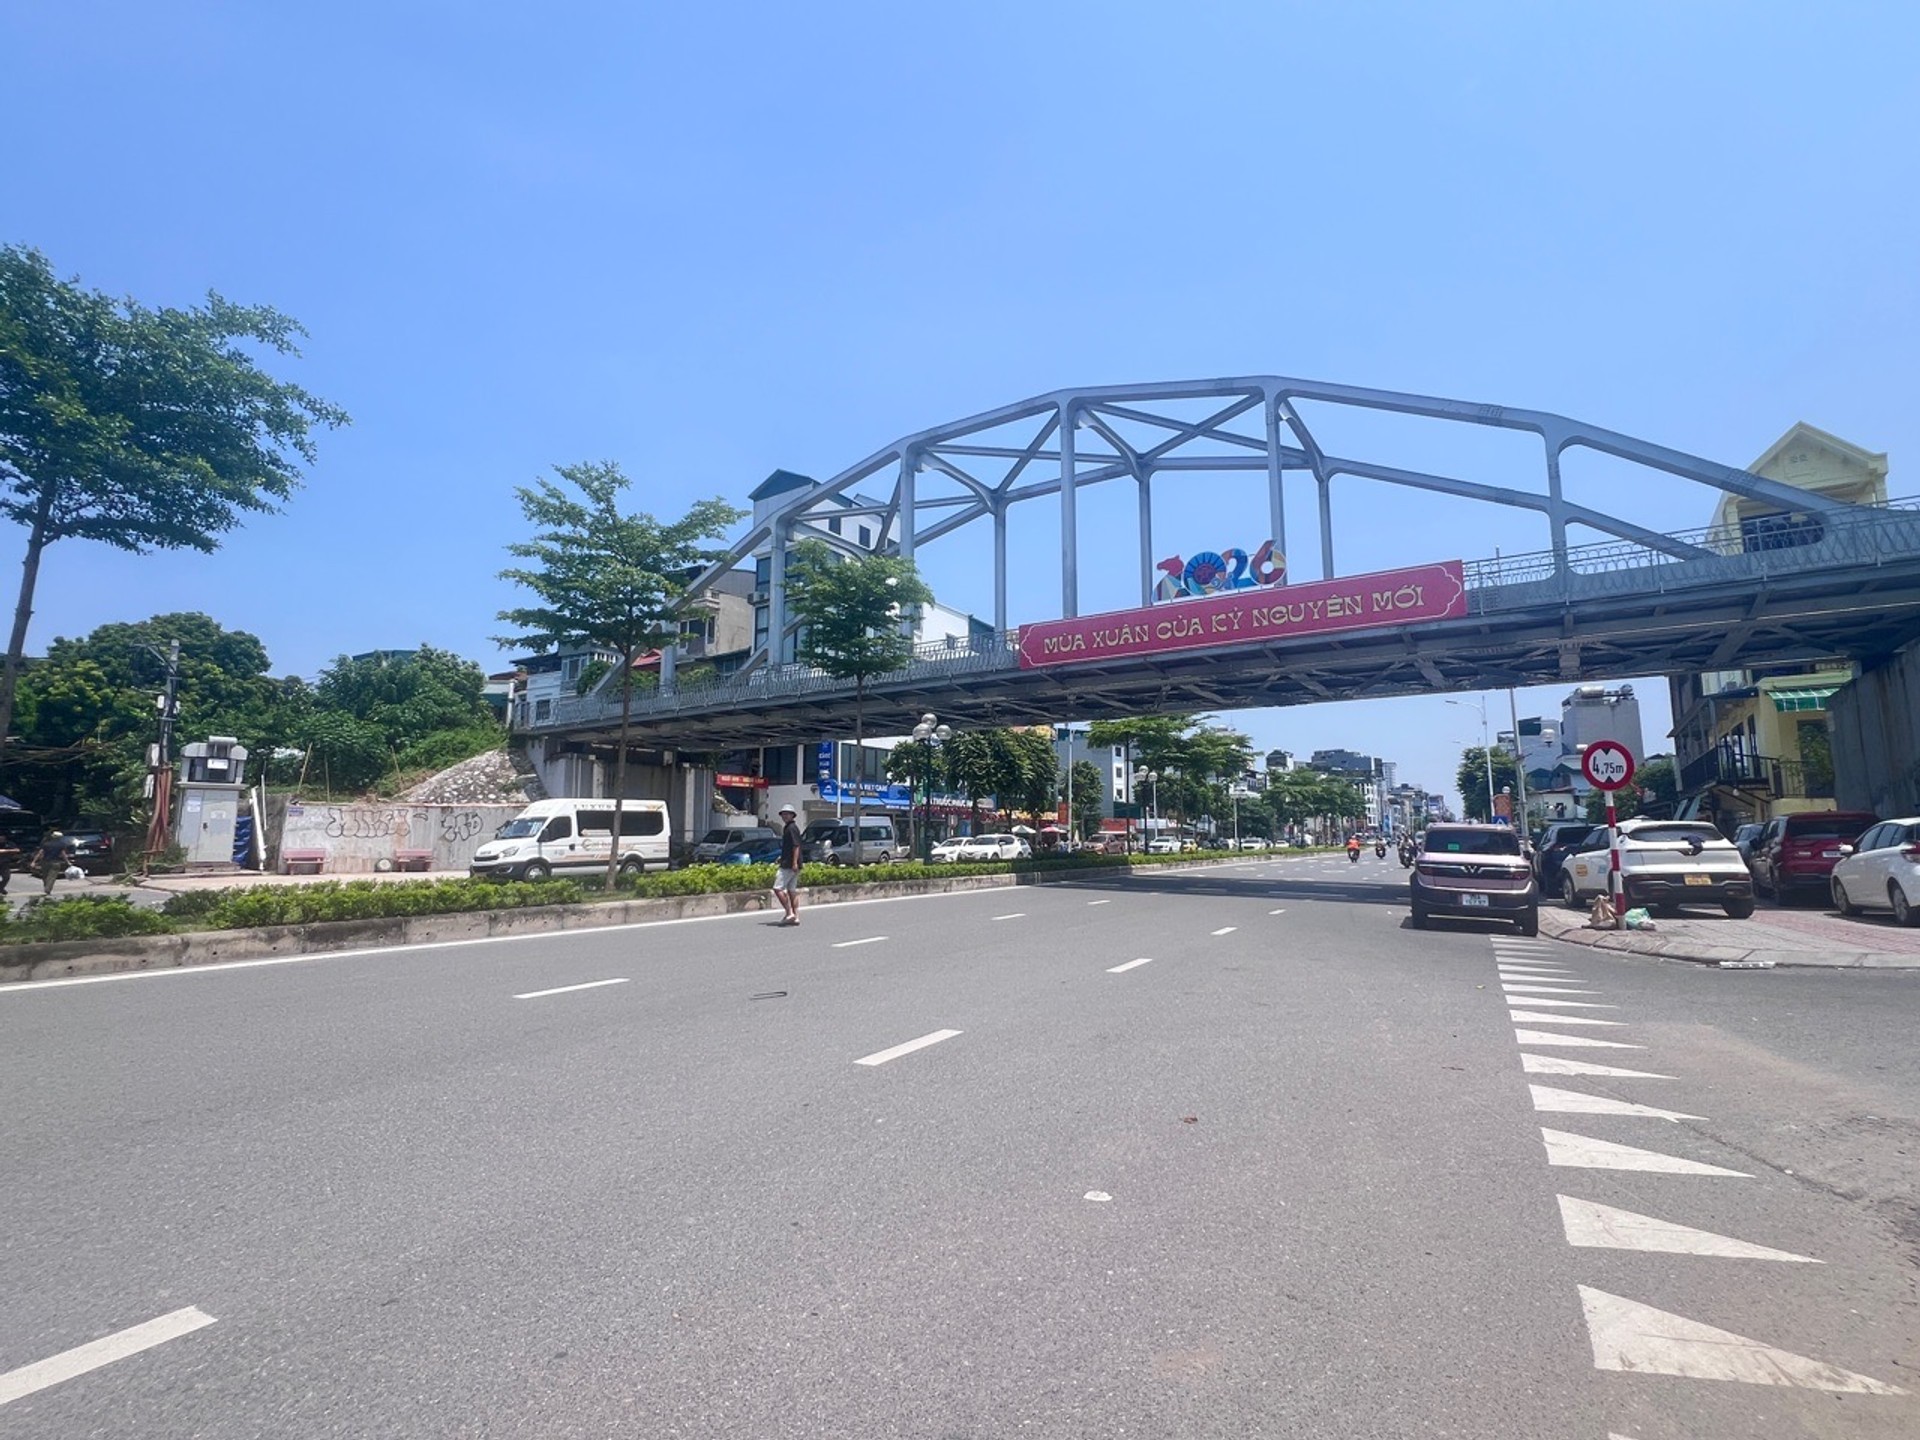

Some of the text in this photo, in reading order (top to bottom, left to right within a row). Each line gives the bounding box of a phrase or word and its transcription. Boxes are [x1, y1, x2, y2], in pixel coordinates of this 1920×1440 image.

[1151, 539, 1286, 601] 2026
[1043, 584, 1425, 654] MÙA XUÂN CỦA KỶ NGUYÊN MỚI
